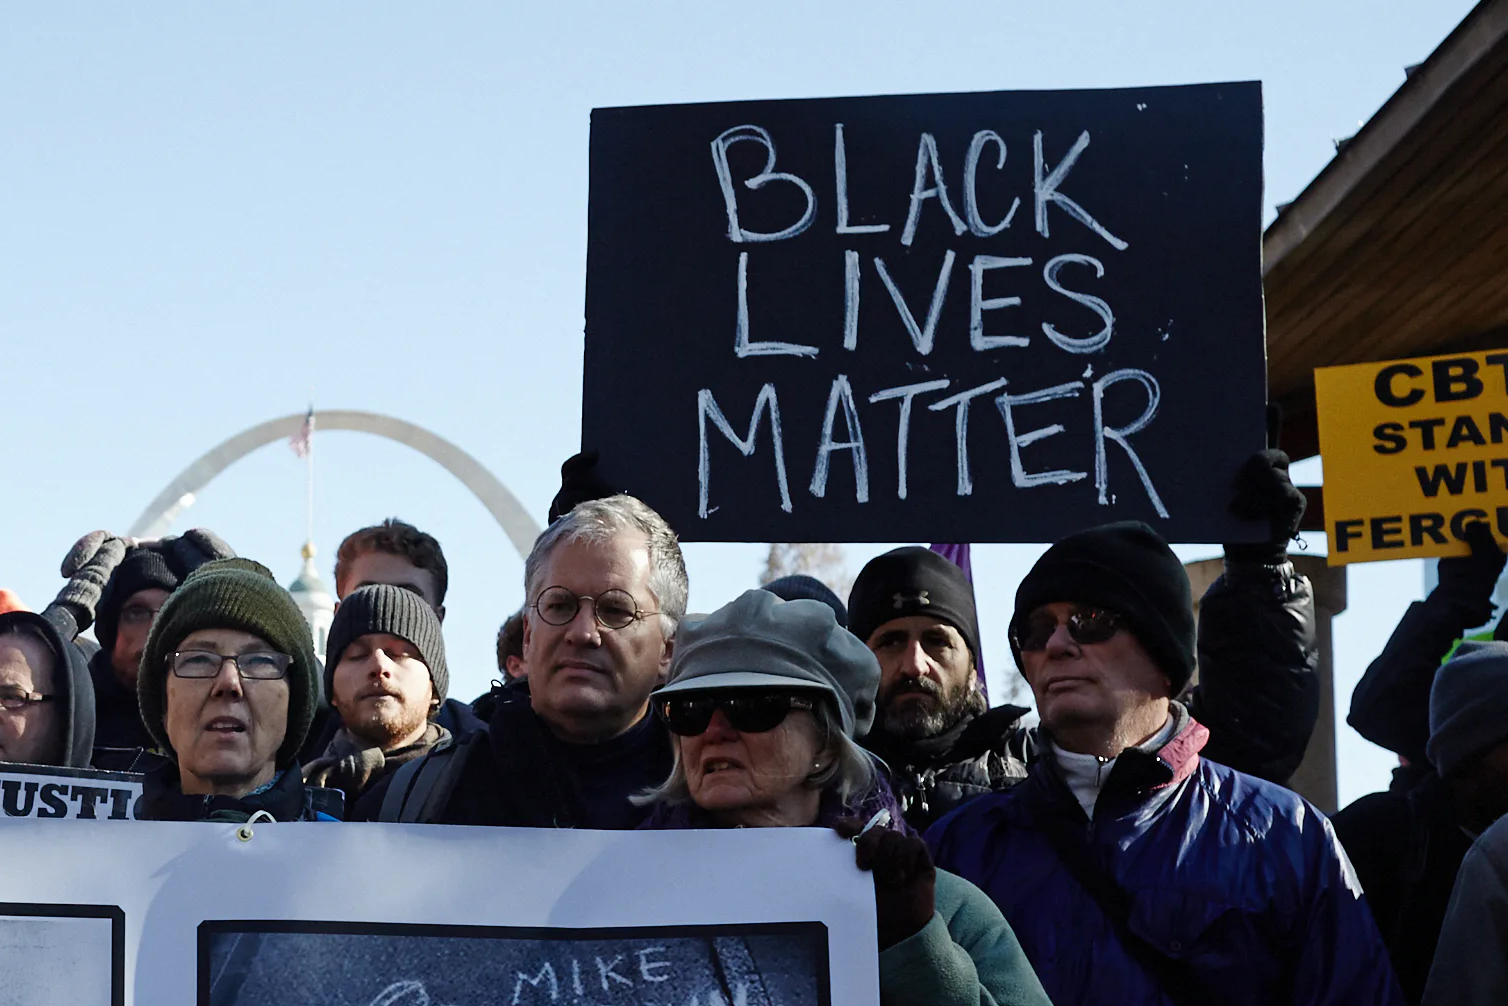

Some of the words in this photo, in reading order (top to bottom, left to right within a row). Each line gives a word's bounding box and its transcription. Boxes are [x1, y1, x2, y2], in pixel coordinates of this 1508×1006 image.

[711, 123, 1128, 251] BLACK
[734, 250, 1114, 359] LIVES
[697, 367, 1170, 519] MATTER
[511, 947, 671, 1006] MIKE
